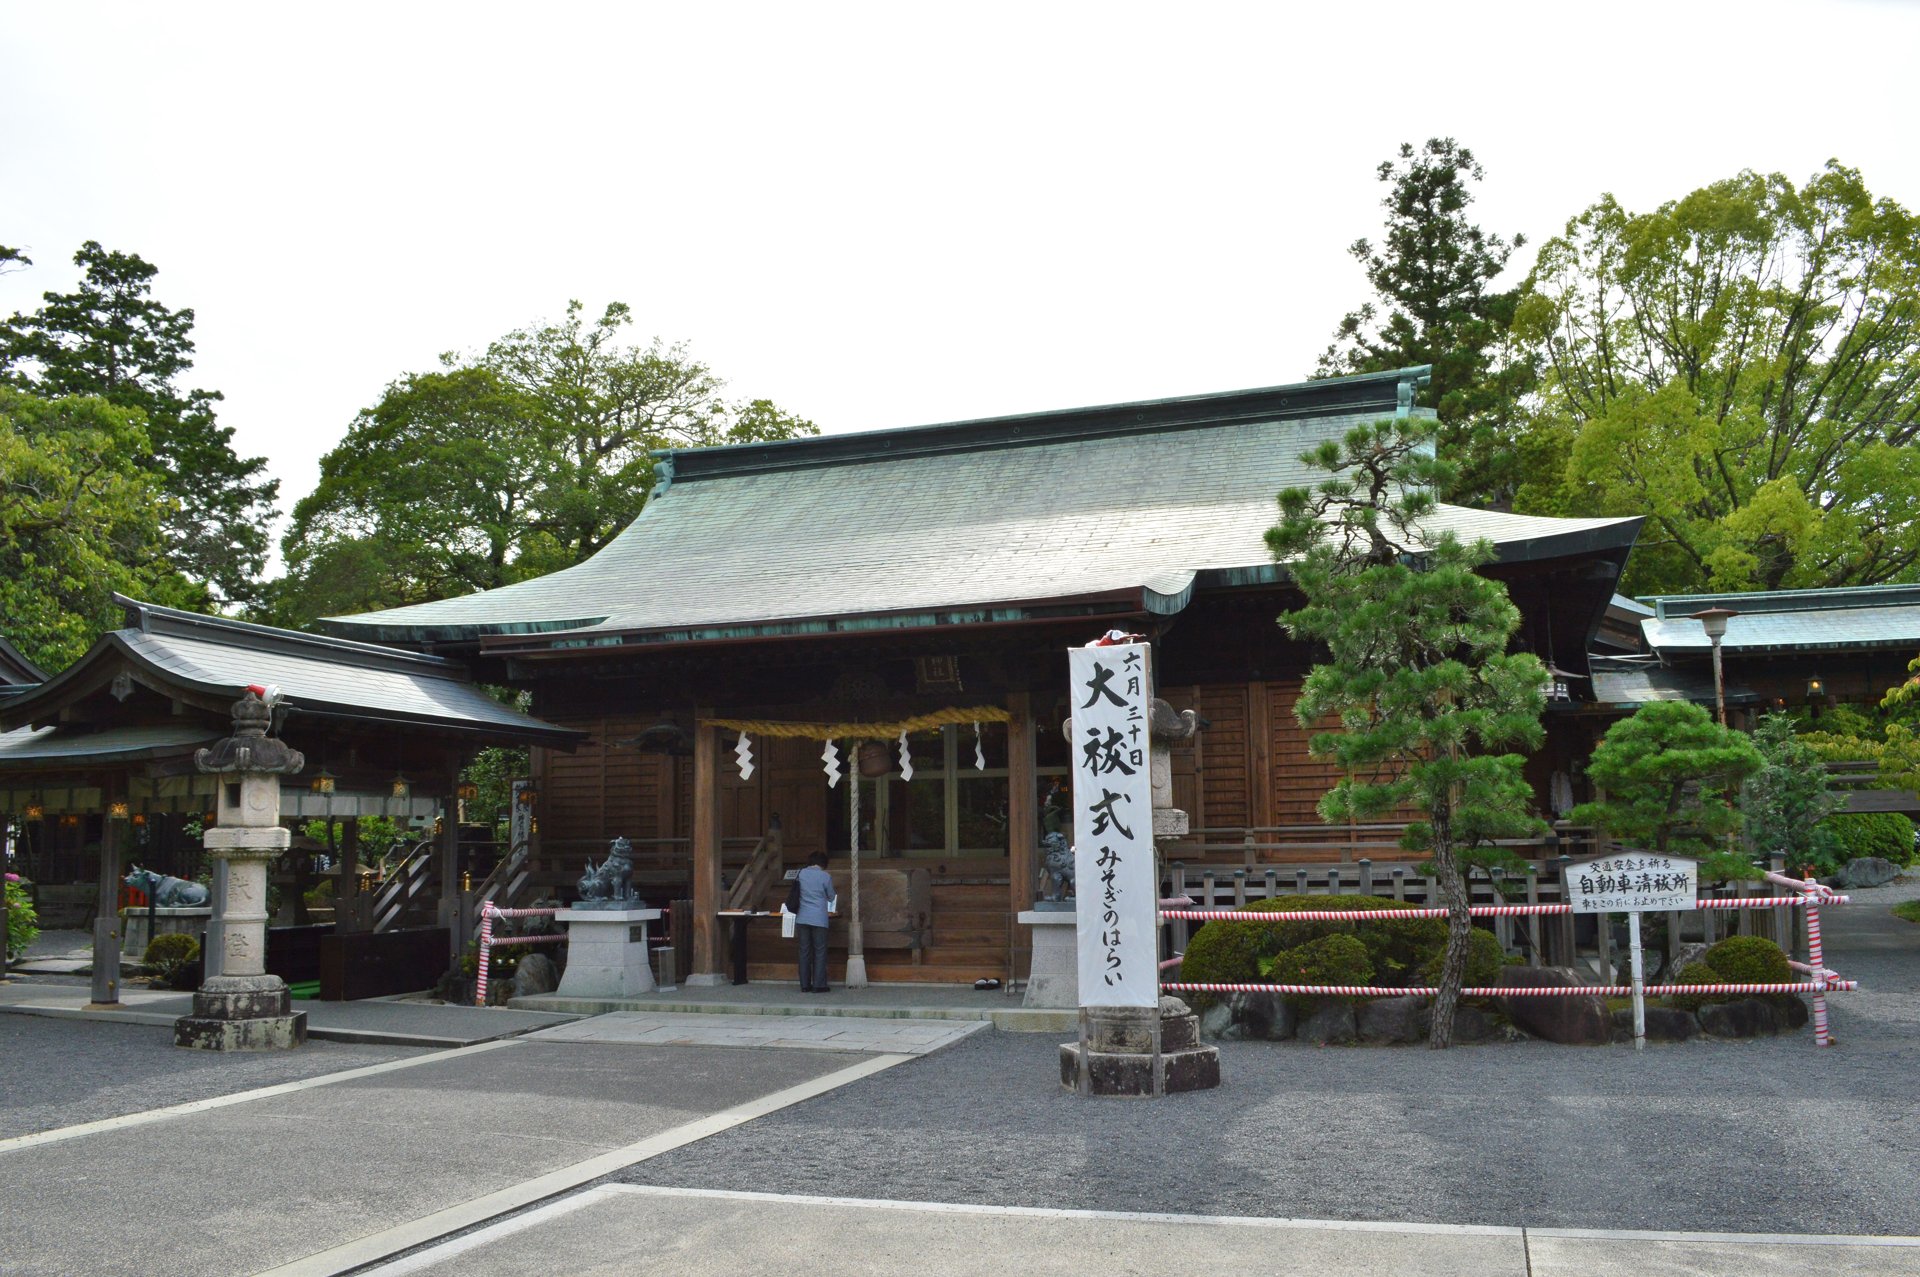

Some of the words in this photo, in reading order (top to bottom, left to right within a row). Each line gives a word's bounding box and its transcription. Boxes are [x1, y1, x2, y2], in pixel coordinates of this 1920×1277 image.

[1081, 662, 1136, 840] 大祓式
[1123, 651, 1144, 768] 六月三十日
[1095, 845, 1123, 988] みそぎのはらい
[1579, 872, 1690, 895] 自動車清祓所
[1590, 858, 1671, 873] 交通安全を祈る
